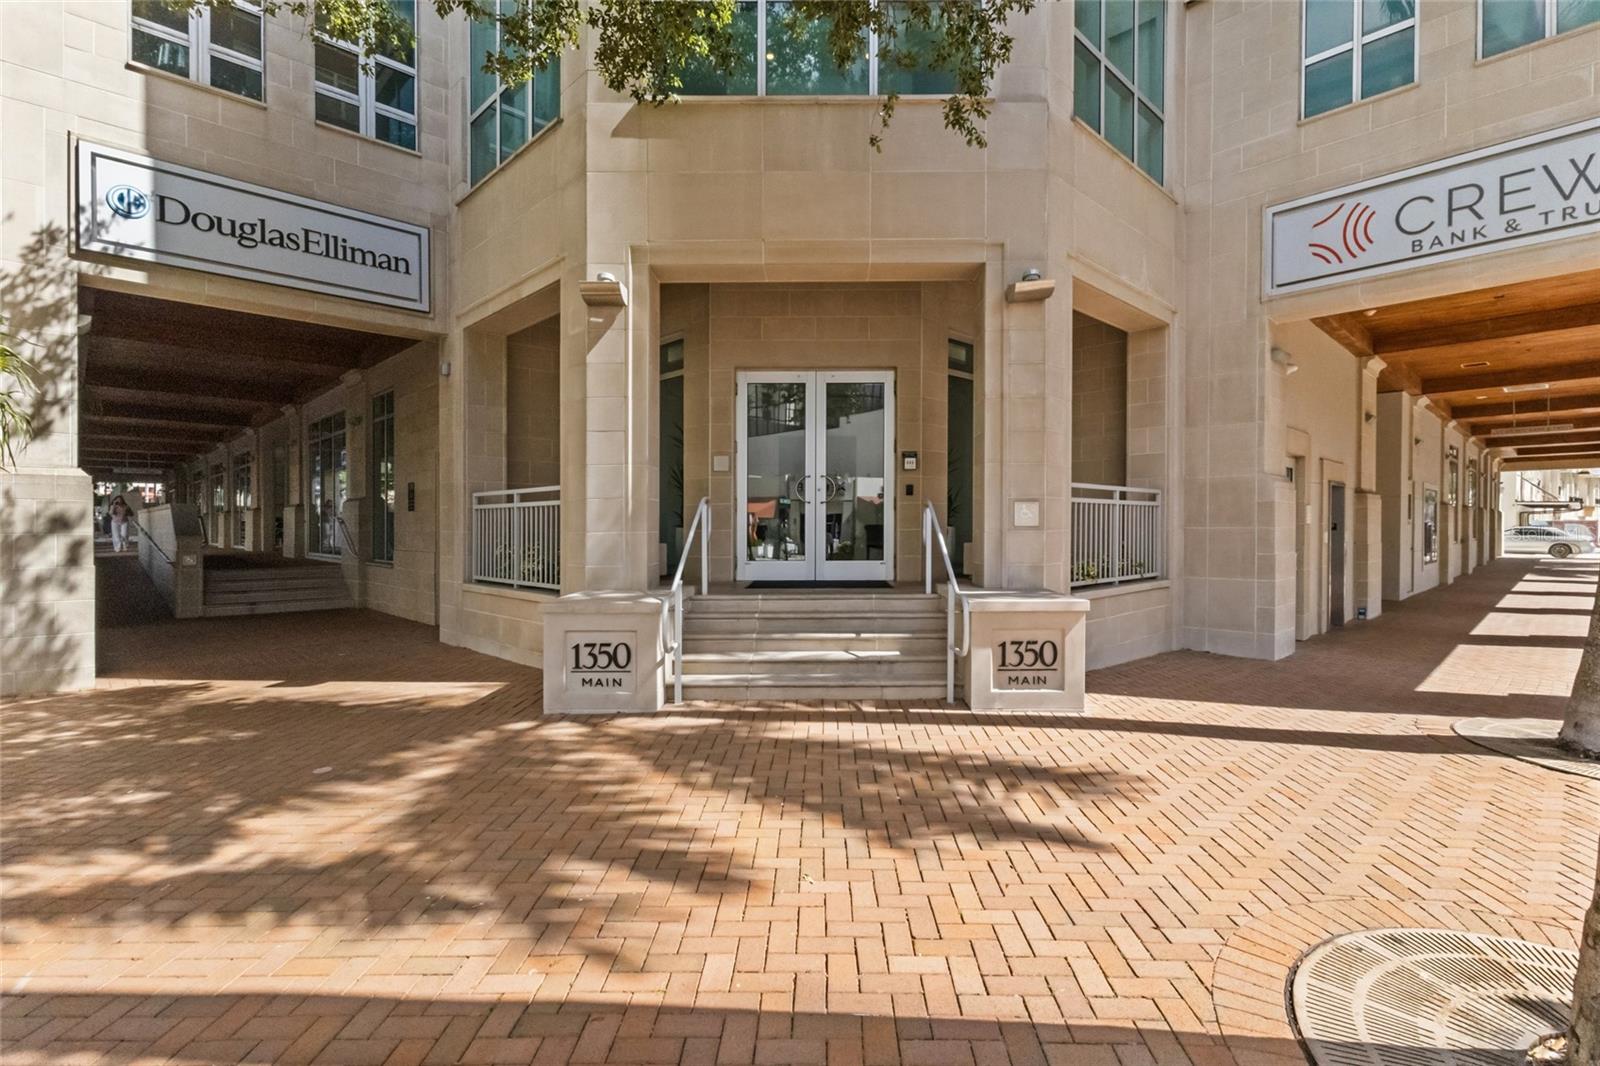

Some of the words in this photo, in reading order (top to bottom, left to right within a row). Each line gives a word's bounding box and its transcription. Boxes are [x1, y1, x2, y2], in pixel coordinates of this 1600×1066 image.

[1395, 152, 1600, 236] CREW
[1411, 224, 1487, 253] BANK
[1504, 218, 1522, 233] &
[1538, 199, 1600, 225] TRU
[571, 642, 632, 670] 1350
[997, 640, 1059, 668] 1350
[581, 677, 623, 688] MAIN
[1008, 675, 1047, 686] MAIN
